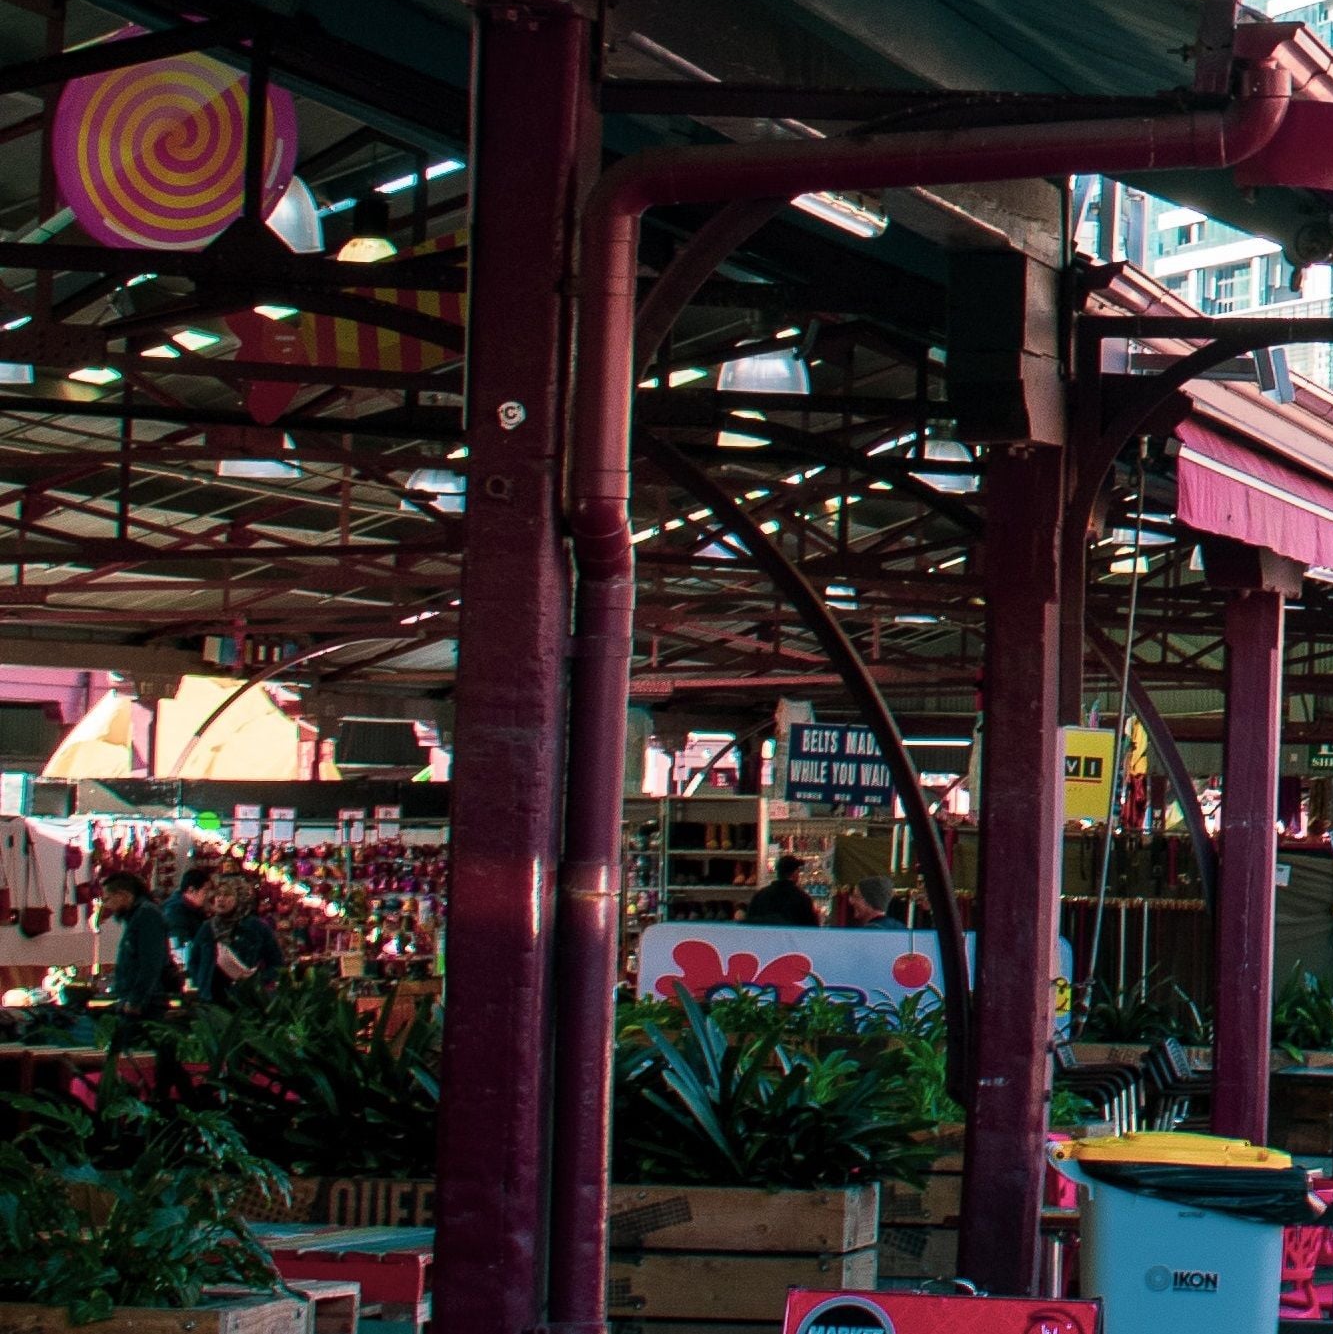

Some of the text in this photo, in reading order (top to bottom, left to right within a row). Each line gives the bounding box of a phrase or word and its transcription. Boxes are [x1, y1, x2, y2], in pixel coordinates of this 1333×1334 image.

[802, 729, 840, 754] BELTS
[791, 759, 828, 784] WHILE
[832, 762, 857, 786] YOU
[1172, 1271, 1219, 1292] IKON
